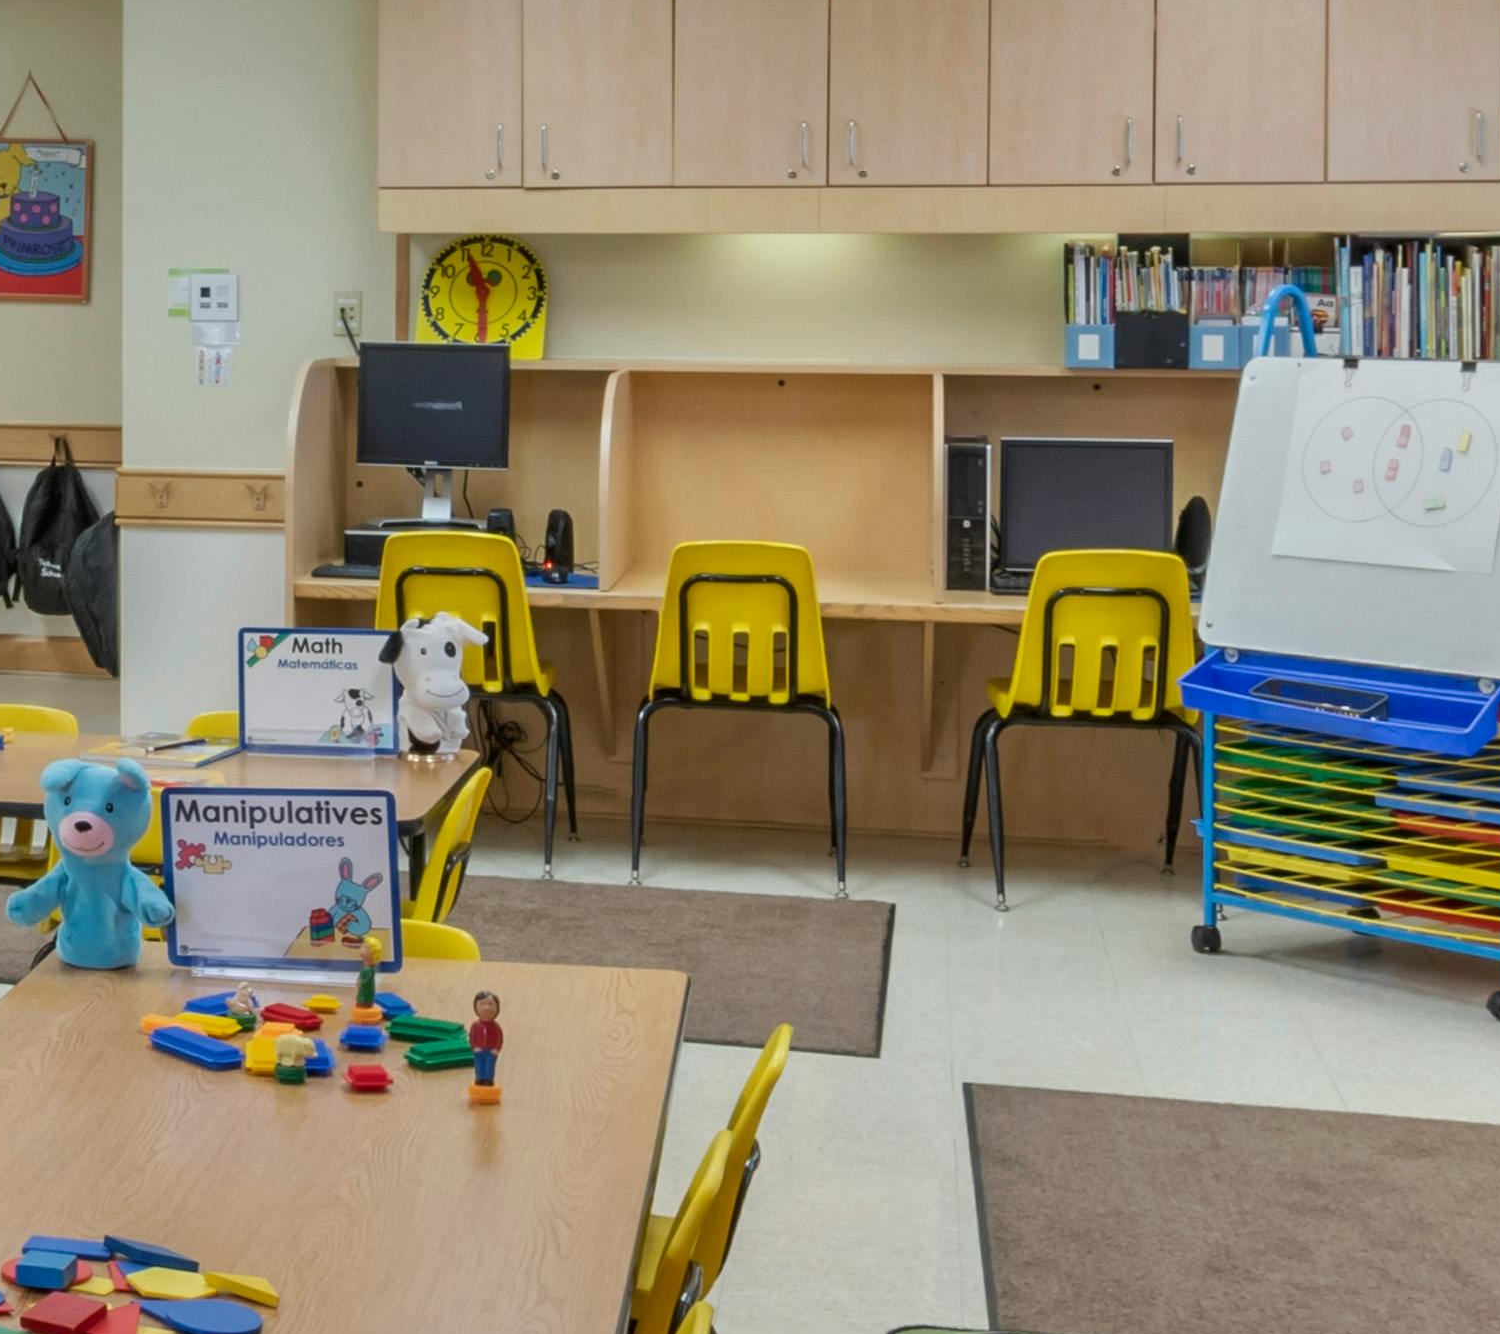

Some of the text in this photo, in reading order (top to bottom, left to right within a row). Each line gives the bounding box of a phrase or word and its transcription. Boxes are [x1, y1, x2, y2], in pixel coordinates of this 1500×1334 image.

[3, 234, 71, 256] PRIMROSE
[480, 244, 494, 258] 12
[440, 264, 456, 279] 10
[521, 265, 532, 279] 2
[430, 285, 441, 298] 9
[527, 287, 537, 301] 3
[435, 307, 445, 321] 8
[518, 309, 528, 320] 4
[453, 323, 464, 337] 7
[500, 323, 510, 337] 5
[292, 637, 343, 655] Math
[277, 659, 358, 671] Matemáticas
[175, 798, 383, 829] Manipulatives
[213, 831, 345, 849] Manipuladores
